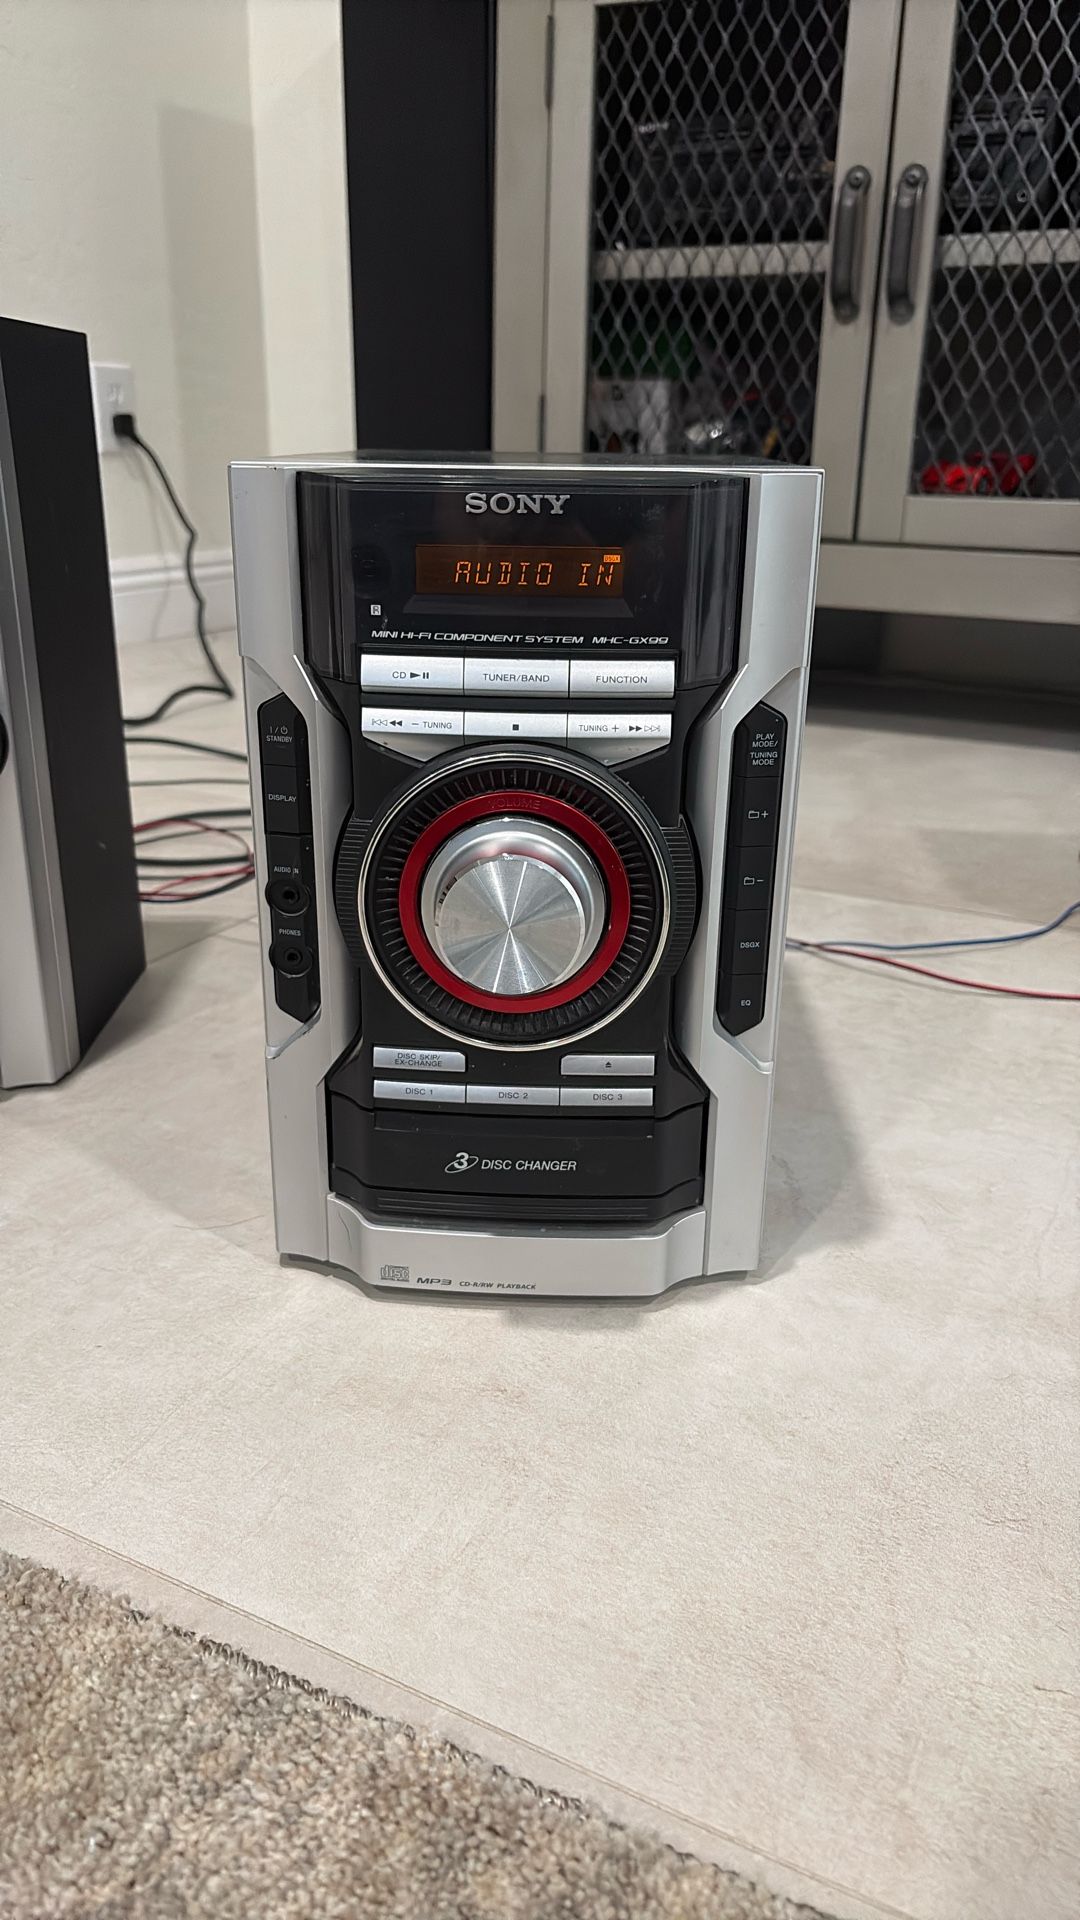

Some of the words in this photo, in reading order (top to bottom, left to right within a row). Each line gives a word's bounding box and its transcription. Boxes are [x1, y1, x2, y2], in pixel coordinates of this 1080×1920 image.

[465, 493, 570, 515] SONY
[455, 561, 553, 586] AUDIO
[578, 563, 614, 587] IN
[371, 630, 398, 639] MINI
[400, 632, 431, 640] HI-FI
[434, 632, 523, 643] COMPONENT
[525, 635, 584, 644] SYSTEM
[592, 636, 669, 645] MHC-GX99
[392, 671, 406, 679] CD
[483, 673, 550, 683] TUNER/BAND
[596, 675, 648, 684] FUNCTION
[423, 721, 452, 730] TUNING
[579, 725, 609, 733] TUNING
[266, 734, 293, 743] STANDBY
[752, 740, 779, 748] MODE/
[750, 751, 778, 759] TUNING
[752, 758, 775, 766] MODE
[268, 793, 297, 803] DISPLAY
[488, 797, 541, 810] VOLUME
[273, 865, 291, 873] AUDIO
[279, 928, 302, 937] PHONES
[740, 941, 760, 949] DSGX
[419, 1053, 441, 1061] SKIP/
[394, 1059, 443, 1067] EX-CHANGE
[405, 1087, 426, 1095] DISC
[498, 1091, 520, 1099] DISC
[593, 1093, 614, 1101] DISC
[455, 1152, 469, 1170] 3
[481, 1159, 512, 1170] DISC
[516, 1160, 577, 1171] CHANGER
[416, 1277, 452, 1286] MP3
[459, 1280, 494, 1288] CD-R/RW
